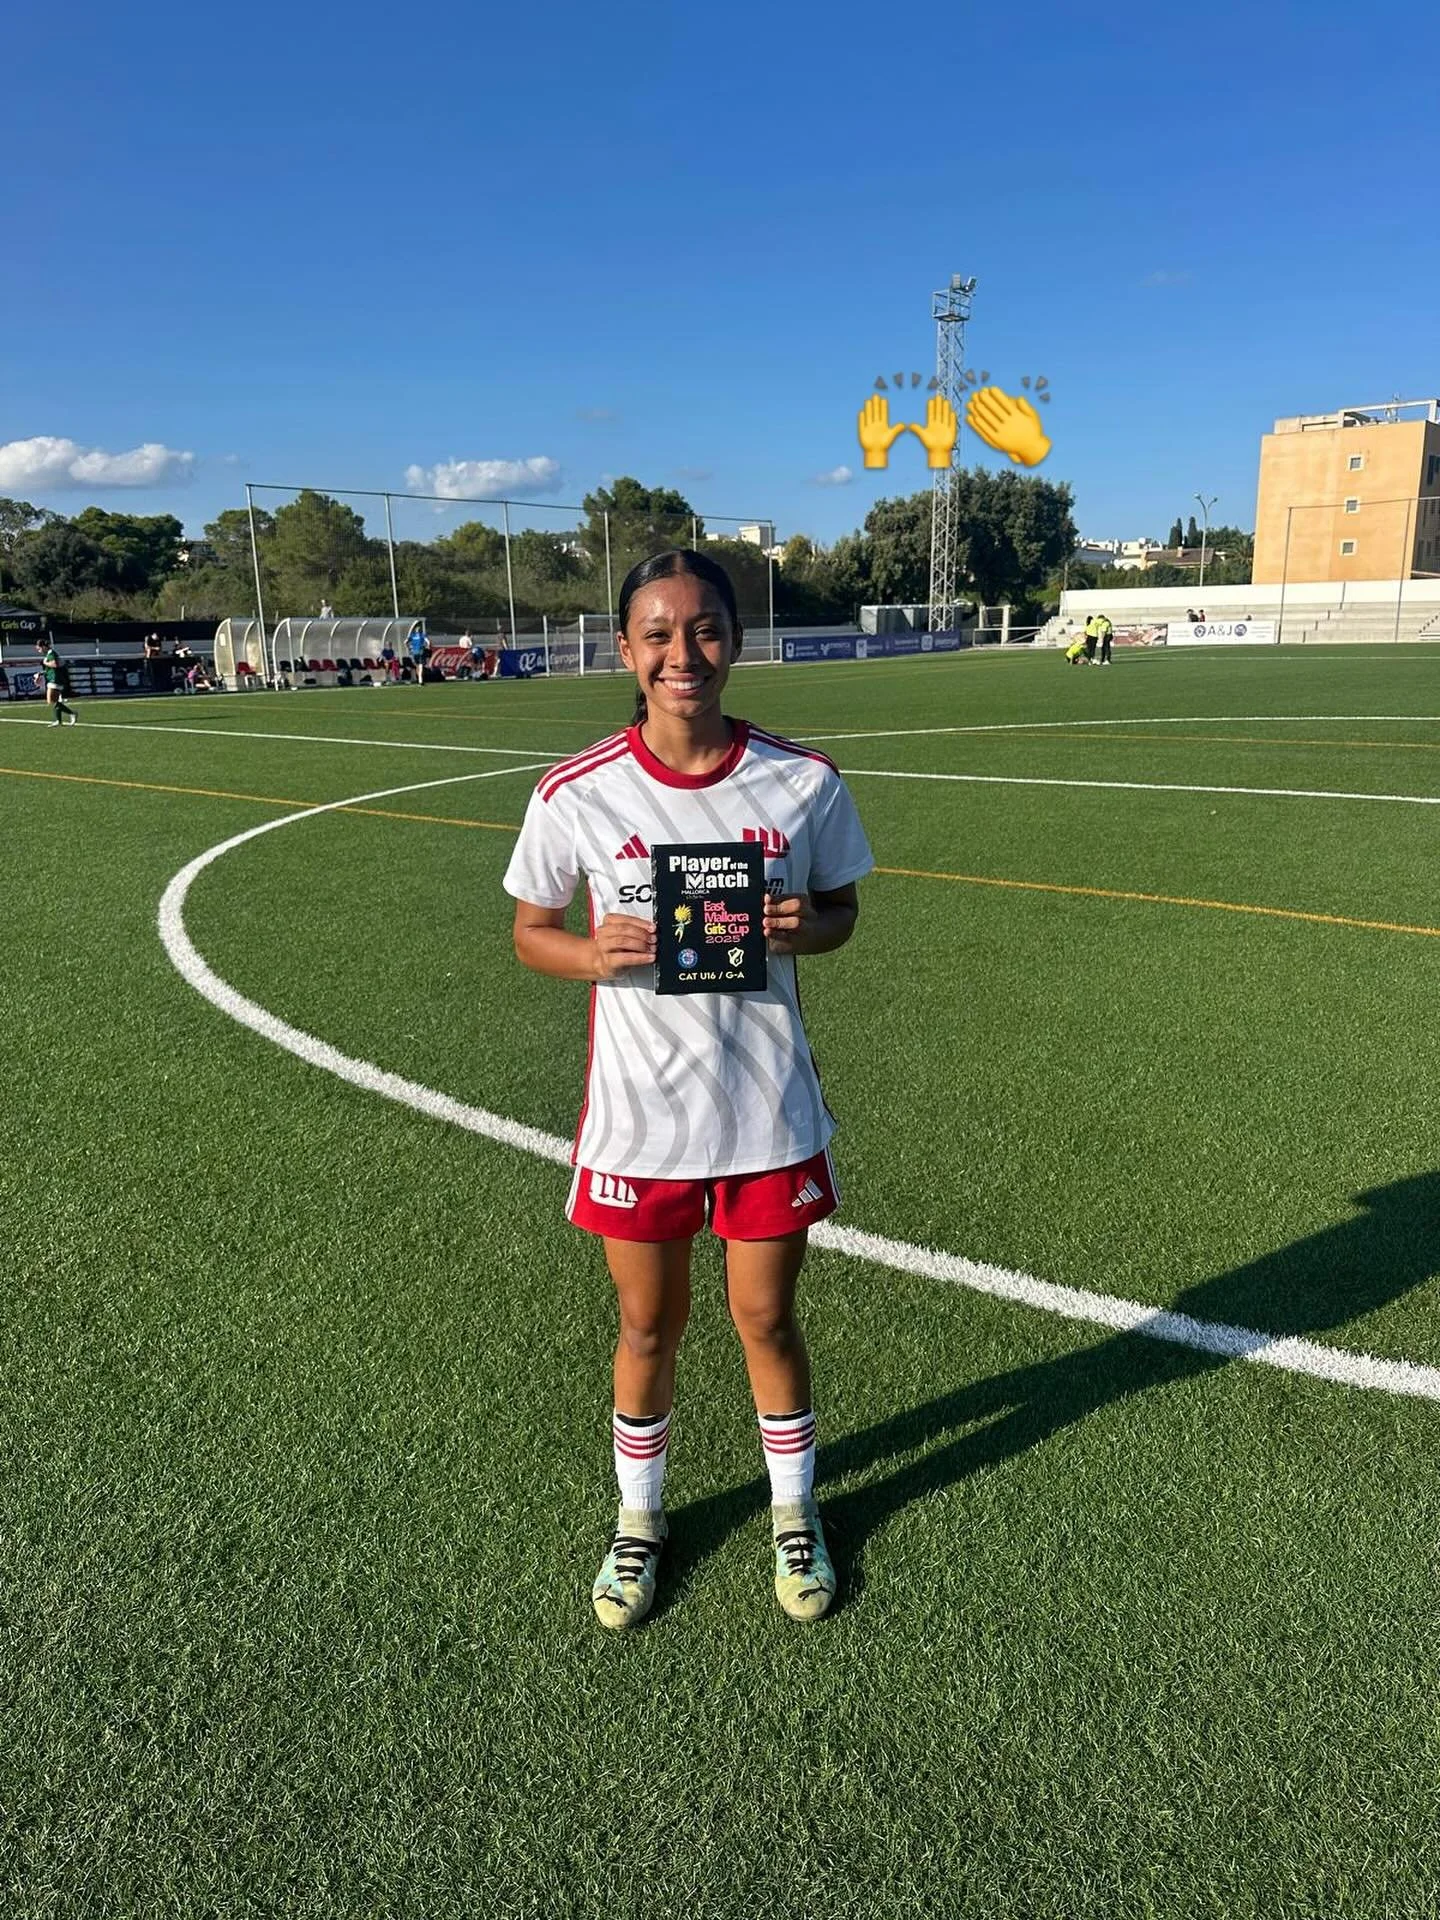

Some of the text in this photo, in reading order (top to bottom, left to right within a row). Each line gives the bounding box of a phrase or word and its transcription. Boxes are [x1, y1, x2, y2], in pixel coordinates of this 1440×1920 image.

[20, 620, 36, 631] Cup
[669, 855, 749, 873] Player of the
[685, 871, 749, 890] Match
[703, 900, 725, 912] East
[704, 911, 750, 923] Mallorca
[704, 923, 750, 937] Girls Cup
[705, 935, 741, 944] 2025
[678, 972, 698, 981] CAT
[699, 971, 717, 980] U16
[725, 971, 745, 979] G-A
